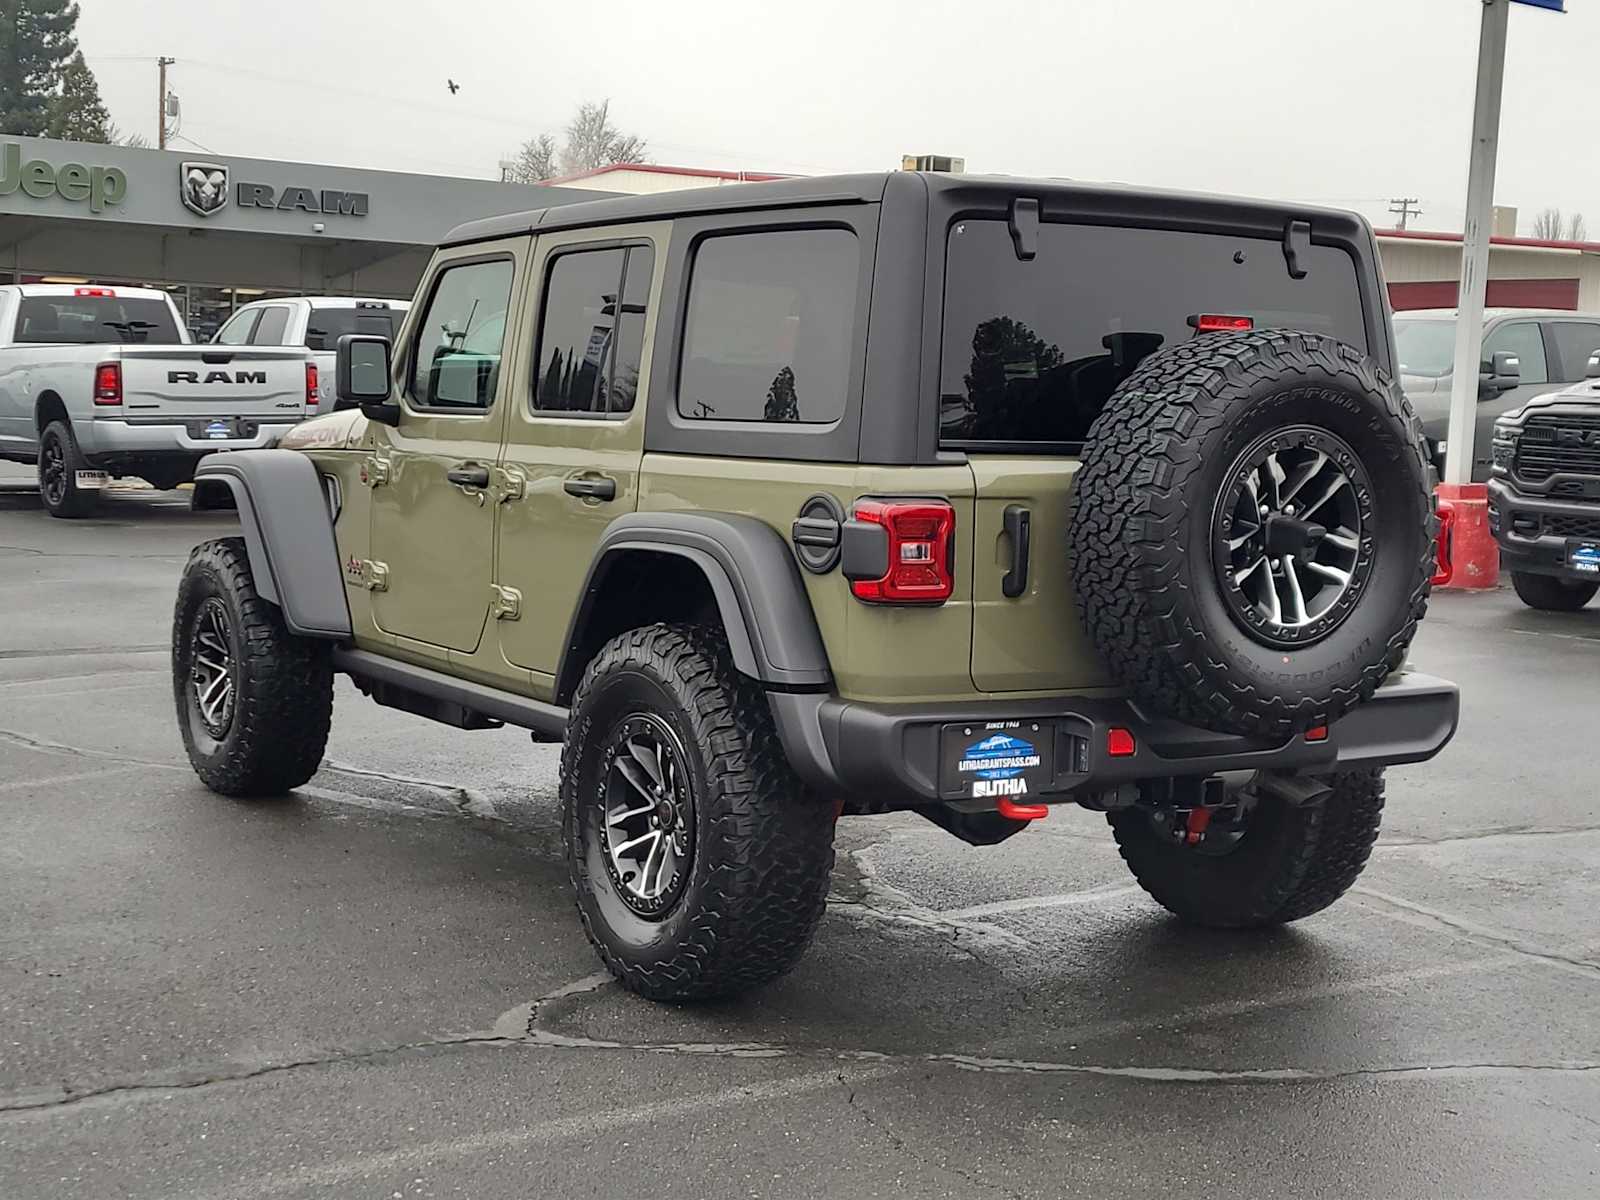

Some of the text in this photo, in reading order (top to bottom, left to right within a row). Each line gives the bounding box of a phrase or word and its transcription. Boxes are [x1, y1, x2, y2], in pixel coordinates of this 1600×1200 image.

[0, 142, 127, 213] Jeep
[237, 181, 369, 216] RAM
[168, 371, 266, 384] RAM
[986, 778, 1028, 796] LITHIA
